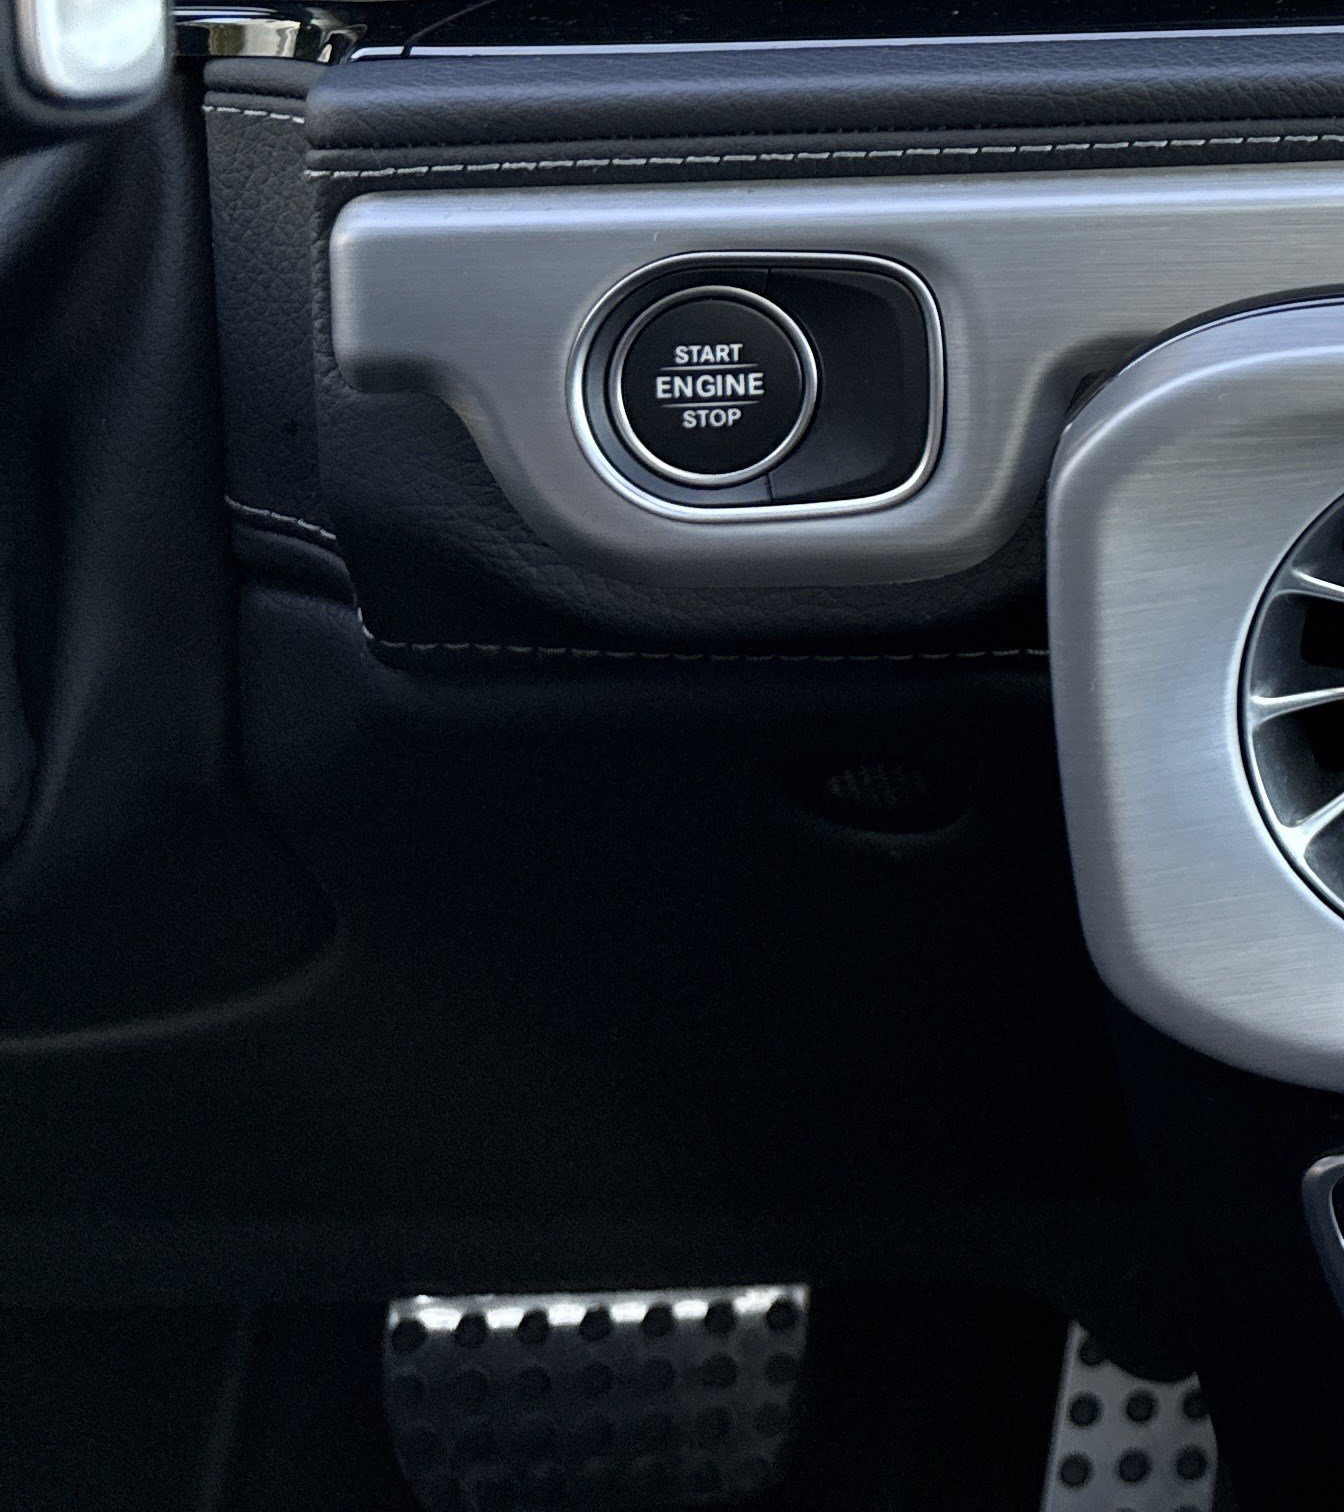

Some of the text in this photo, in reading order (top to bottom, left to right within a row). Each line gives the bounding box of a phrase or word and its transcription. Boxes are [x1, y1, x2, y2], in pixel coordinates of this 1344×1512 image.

[674, 343, 743, 364] START
[655, 372, 765, 400] ENGINE
[682, 407, 742, 429] STOP
